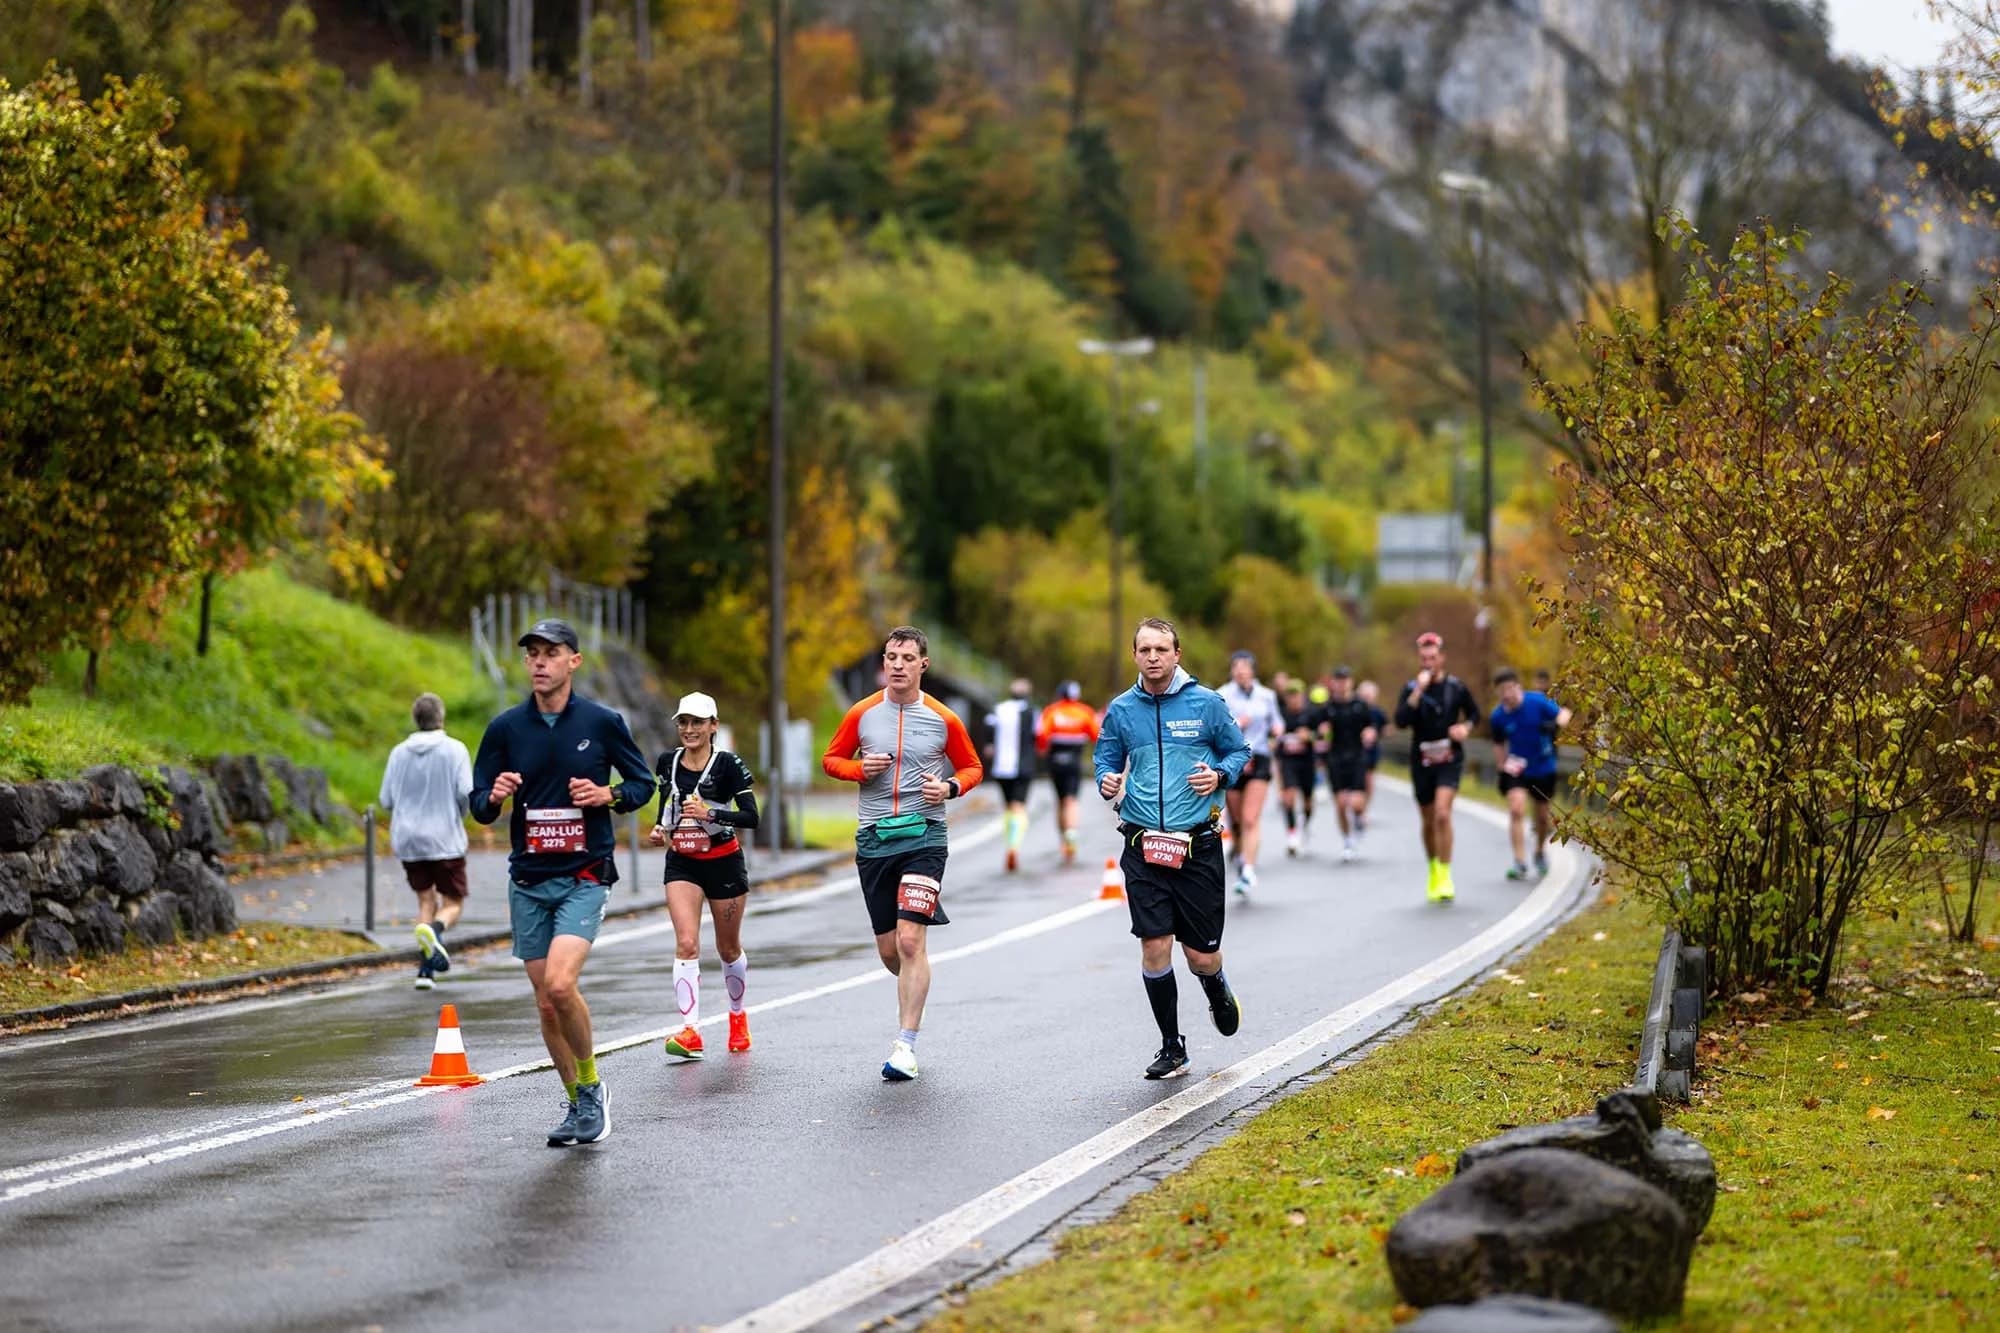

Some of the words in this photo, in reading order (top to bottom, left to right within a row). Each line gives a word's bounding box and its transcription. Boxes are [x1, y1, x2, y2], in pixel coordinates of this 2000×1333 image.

[527, 825, 583, 837] JEAN-LUC
[542, 838, 566, 848] 3275
[1143, 841, 1188, 857] MARWIN
[1152, 851, 1173, 862] 4730
[904, 888, 936, 903] SIMON
